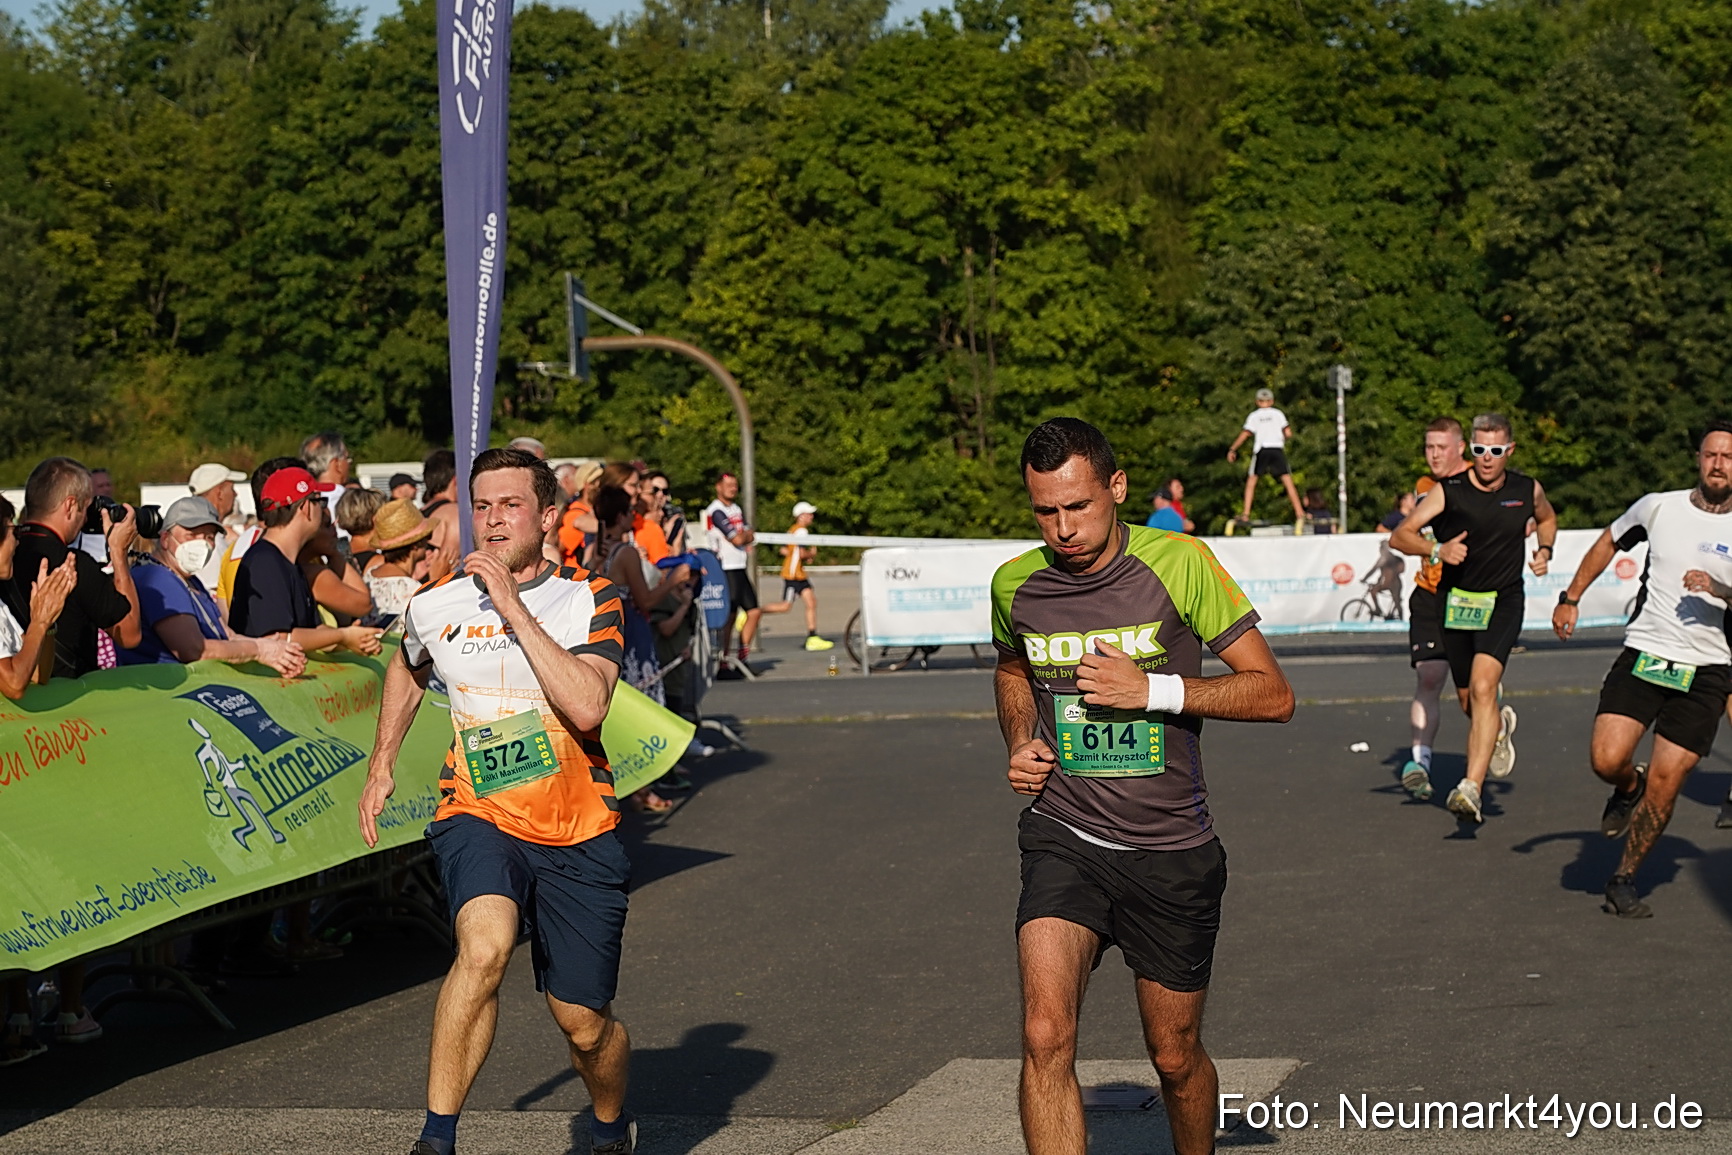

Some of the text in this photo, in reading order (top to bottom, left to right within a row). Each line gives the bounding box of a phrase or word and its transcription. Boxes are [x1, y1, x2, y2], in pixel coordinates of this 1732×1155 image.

[1060, 668, 1074, 679] by
[1063, 733, 1073, 759] RUN
[1082, 724, 1138, 750] 614
[1149, 726, 1160, 763] 2022
[483, 740, 529, 771] 572
[535, 735, 553, 767] 2022
[1073, 751, 1150, 763] Szmit Krzysztof
[471, 760, 482, 784] RUN
[500, 759, 543, 778] Maximilian
[284, 788, 335, 832] neumarkt
